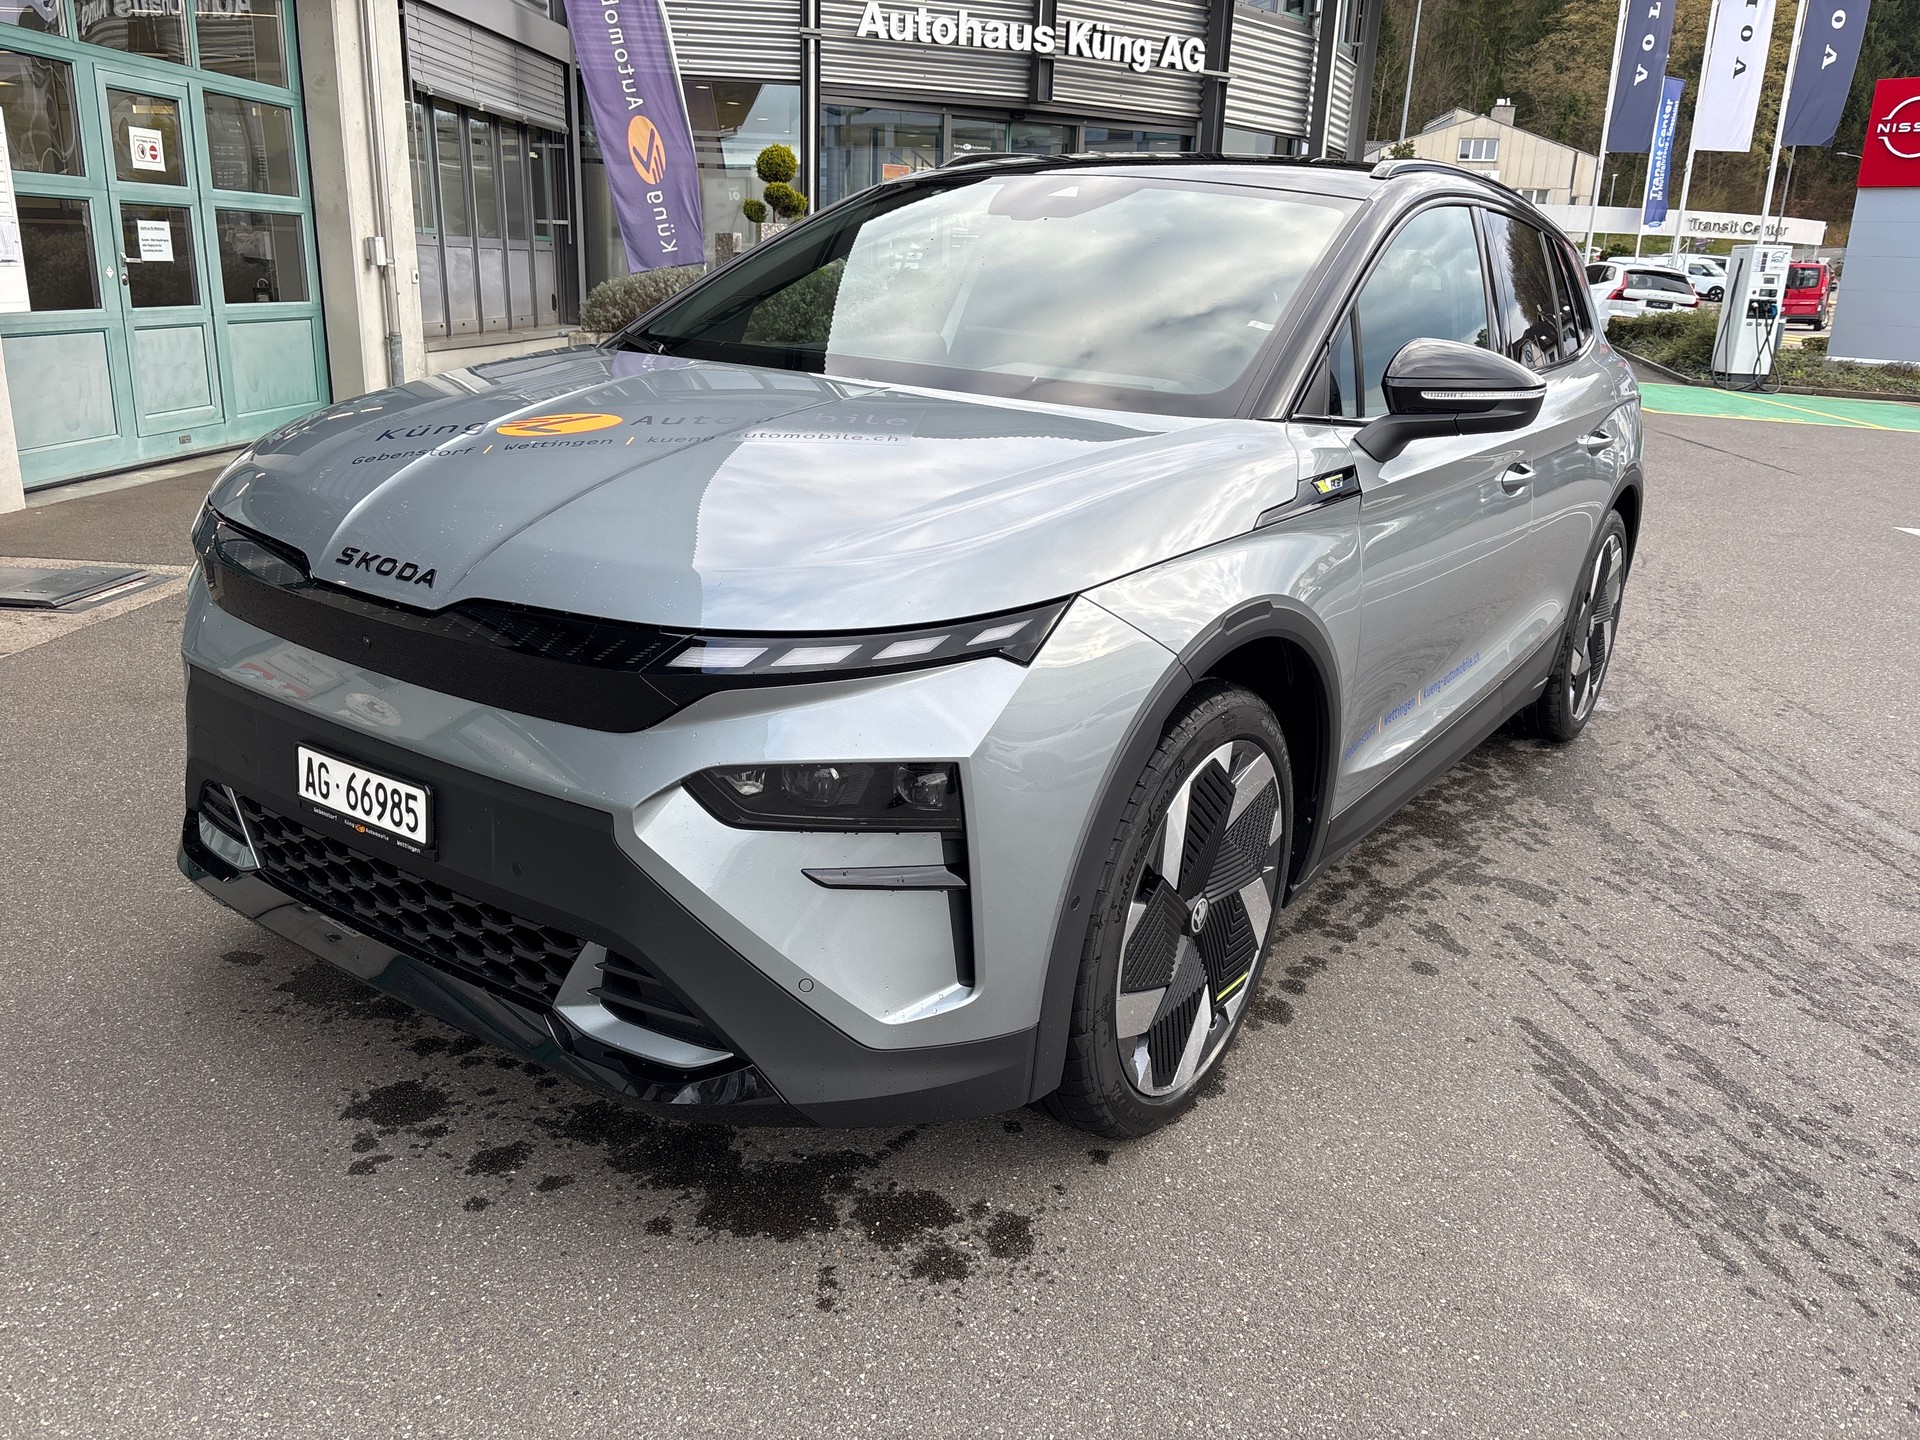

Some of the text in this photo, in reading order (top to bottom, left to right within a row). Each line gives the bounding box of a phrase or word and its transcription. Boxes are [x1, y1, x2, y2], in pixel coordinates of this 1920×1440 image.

[855, 1, 1206, 74] Autohaus Küng AG
[1650, 99, 1674, 201] Transit Center
[1688, 217, 1740, 233] Transit
[375, 422, 489, 442] Küng
[352, 446, 477, 465] Gebenstorf
[504, 438, 614, 452] Wettingen
